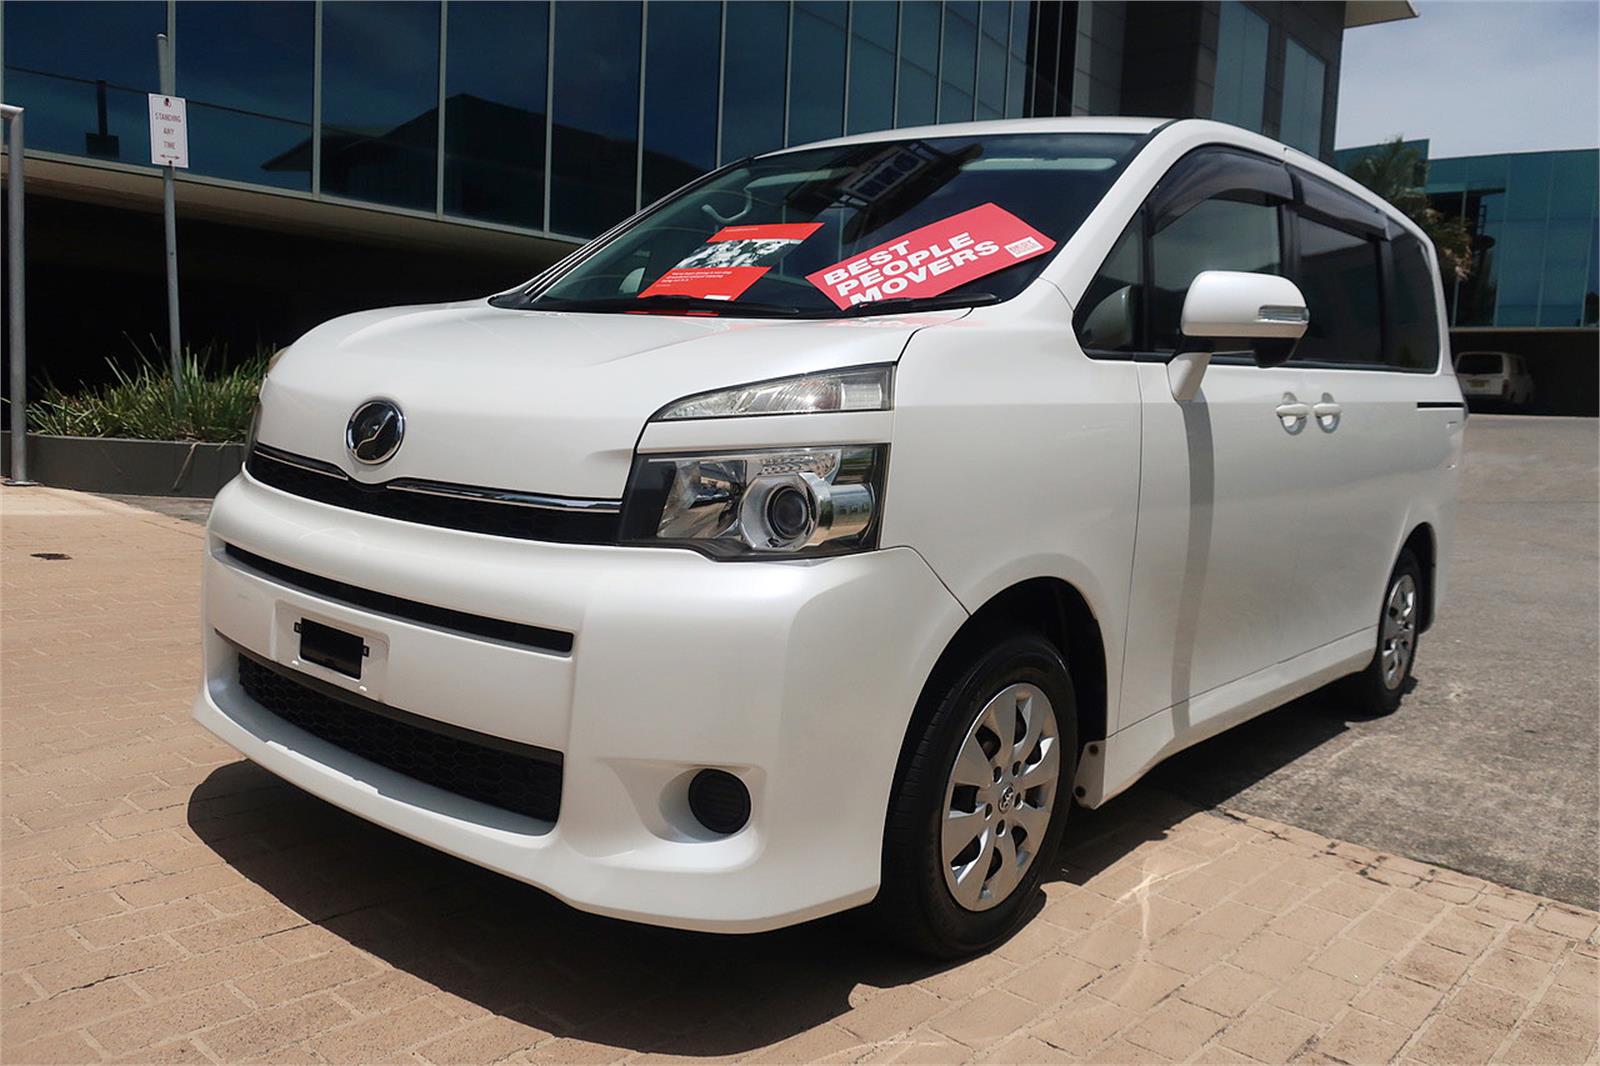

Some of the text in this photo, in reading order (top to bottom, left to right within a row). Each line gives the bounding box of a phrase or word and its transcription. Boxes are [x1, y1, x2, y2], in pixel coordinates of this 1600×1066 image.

[155, 112, 182, 123] STANDING
[163, 127, 175, 135] ANY
[823, 239, 911, 286] BEST
[835, 232, 975, 297] PEOPLE
[849, 240, 1000, 306] MOVERS
